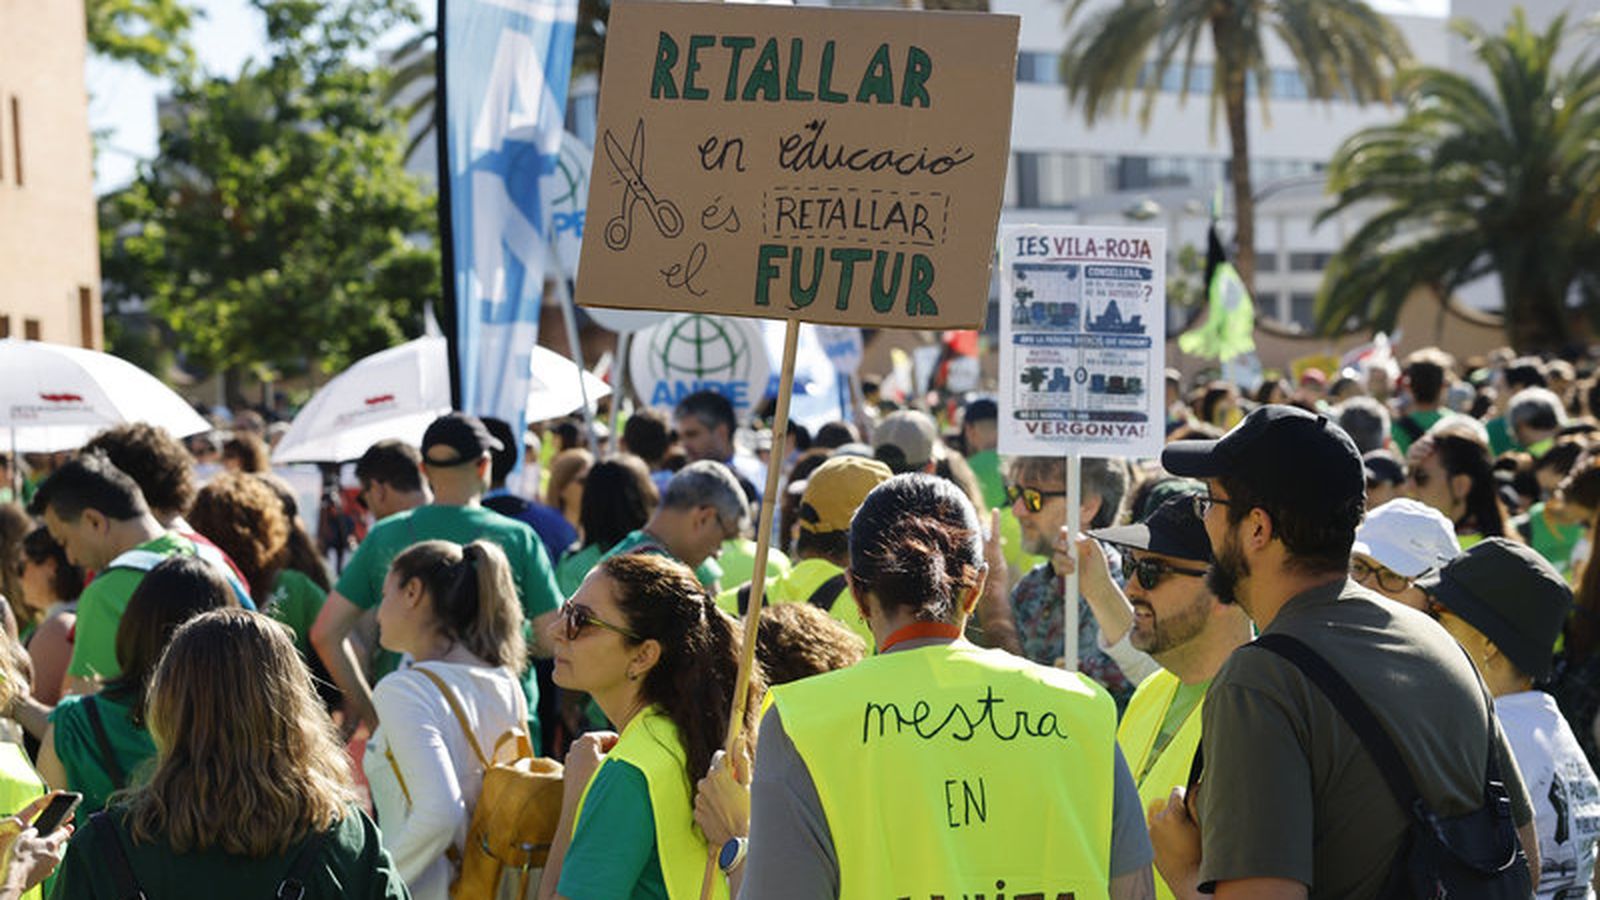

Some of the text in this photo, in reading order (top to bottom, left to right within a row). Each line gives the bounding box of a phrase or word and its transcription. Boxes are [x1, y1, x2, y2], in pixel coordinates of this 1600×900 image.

[650, 31, 933, 108] RETALLAR
[698, 117, 975, 175] en educació
[700, 194, 936, 240] és RETALLAR
[1016, 236, 1153, 260] IES VILA-ROJA
[659, 242, 939, 316] el FUTUR
[1025, 421, 1146, 438] VERGONYA!
[863, 685, 1068, 744] mestra
[944, 776, 986, 828] EN
